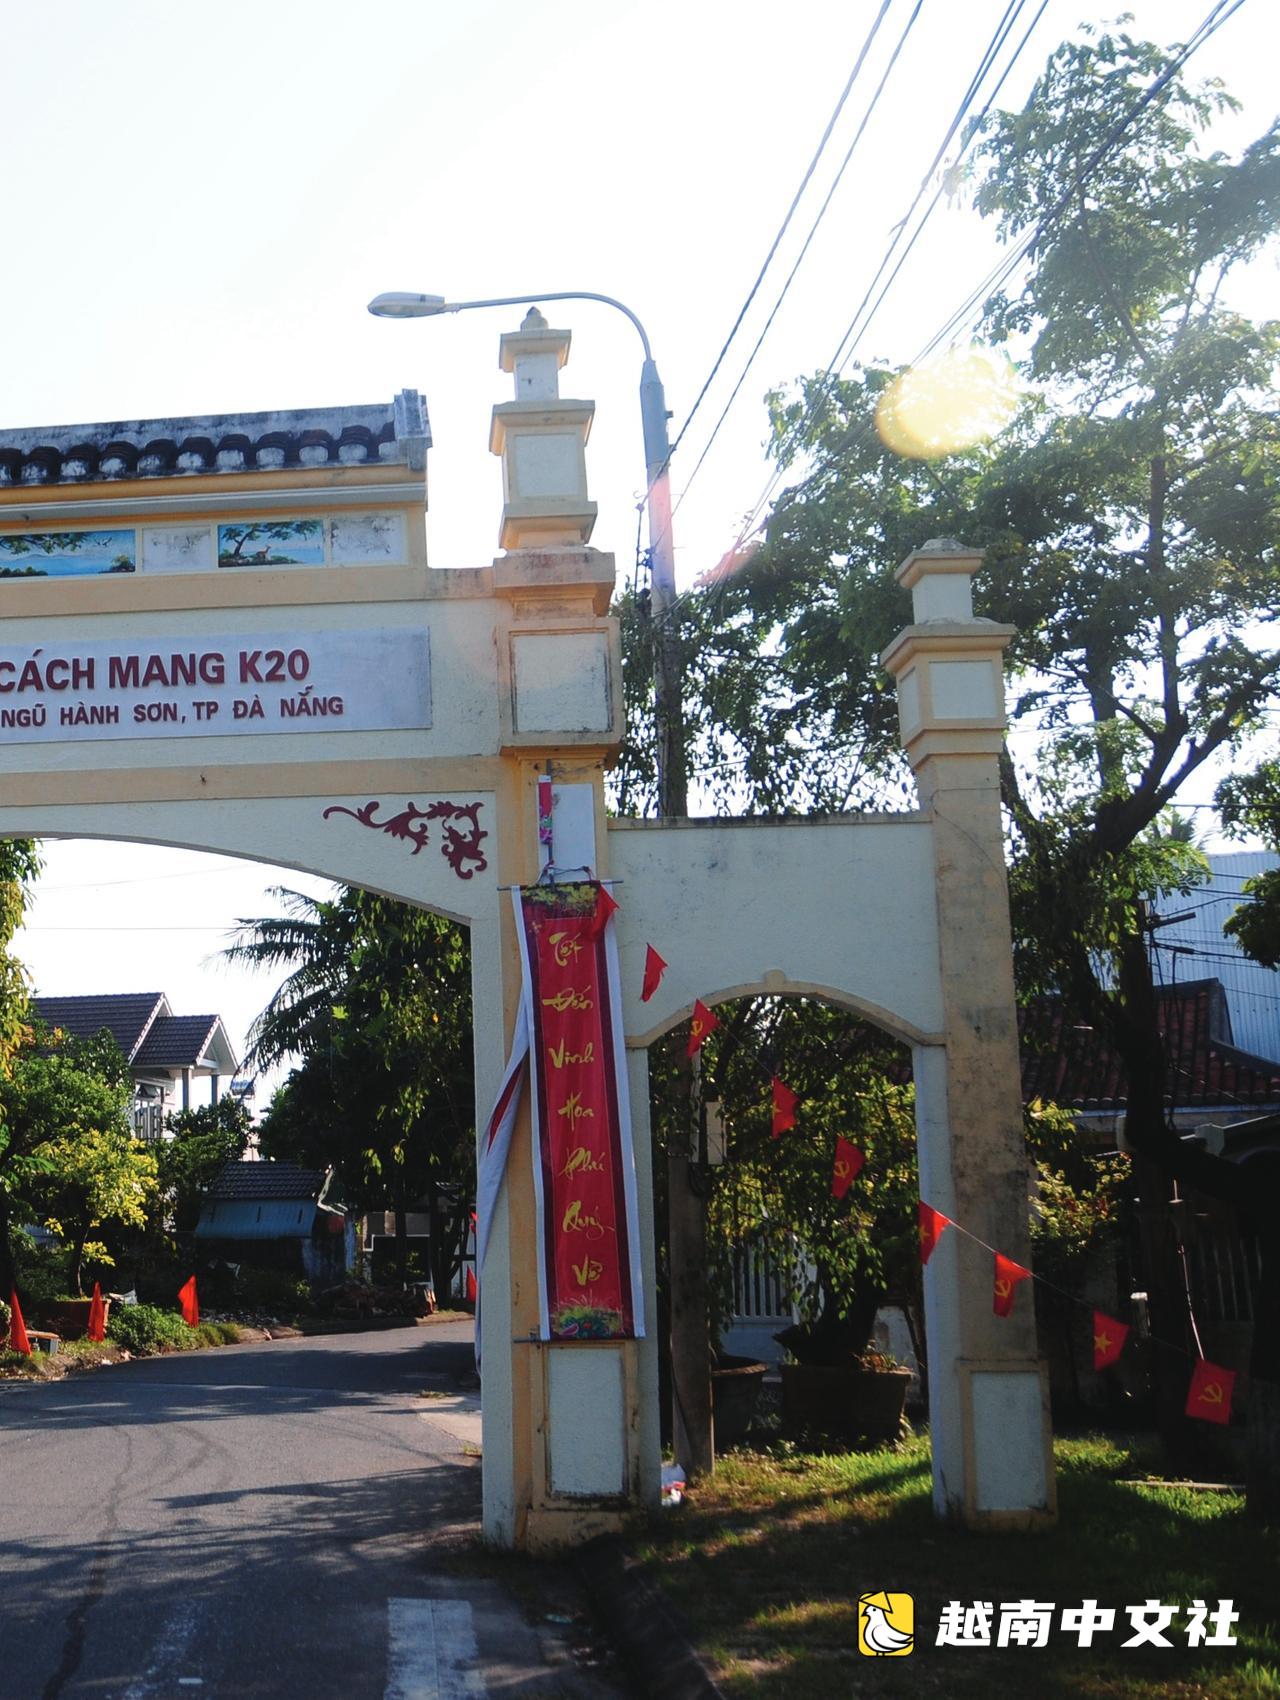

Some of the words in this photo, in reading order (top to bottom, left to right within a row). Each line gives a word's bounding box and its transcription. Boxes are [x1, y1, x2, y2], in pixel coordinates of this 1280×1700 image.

[109, 652, 225, 689] MANG
[239, 648, 310, 683] K20
[1, 703, 47, 728] NGŨ
[60, 701, 119, 726] HÀNH
[192, 701, 219, 720] TP
[232, 694, 265, 719] ĐÀ
[549, 932, 584, 967] Tết
[548, 1038, 595, 1069] Vinh
[558, 1090, 595, 1131] Hoa
